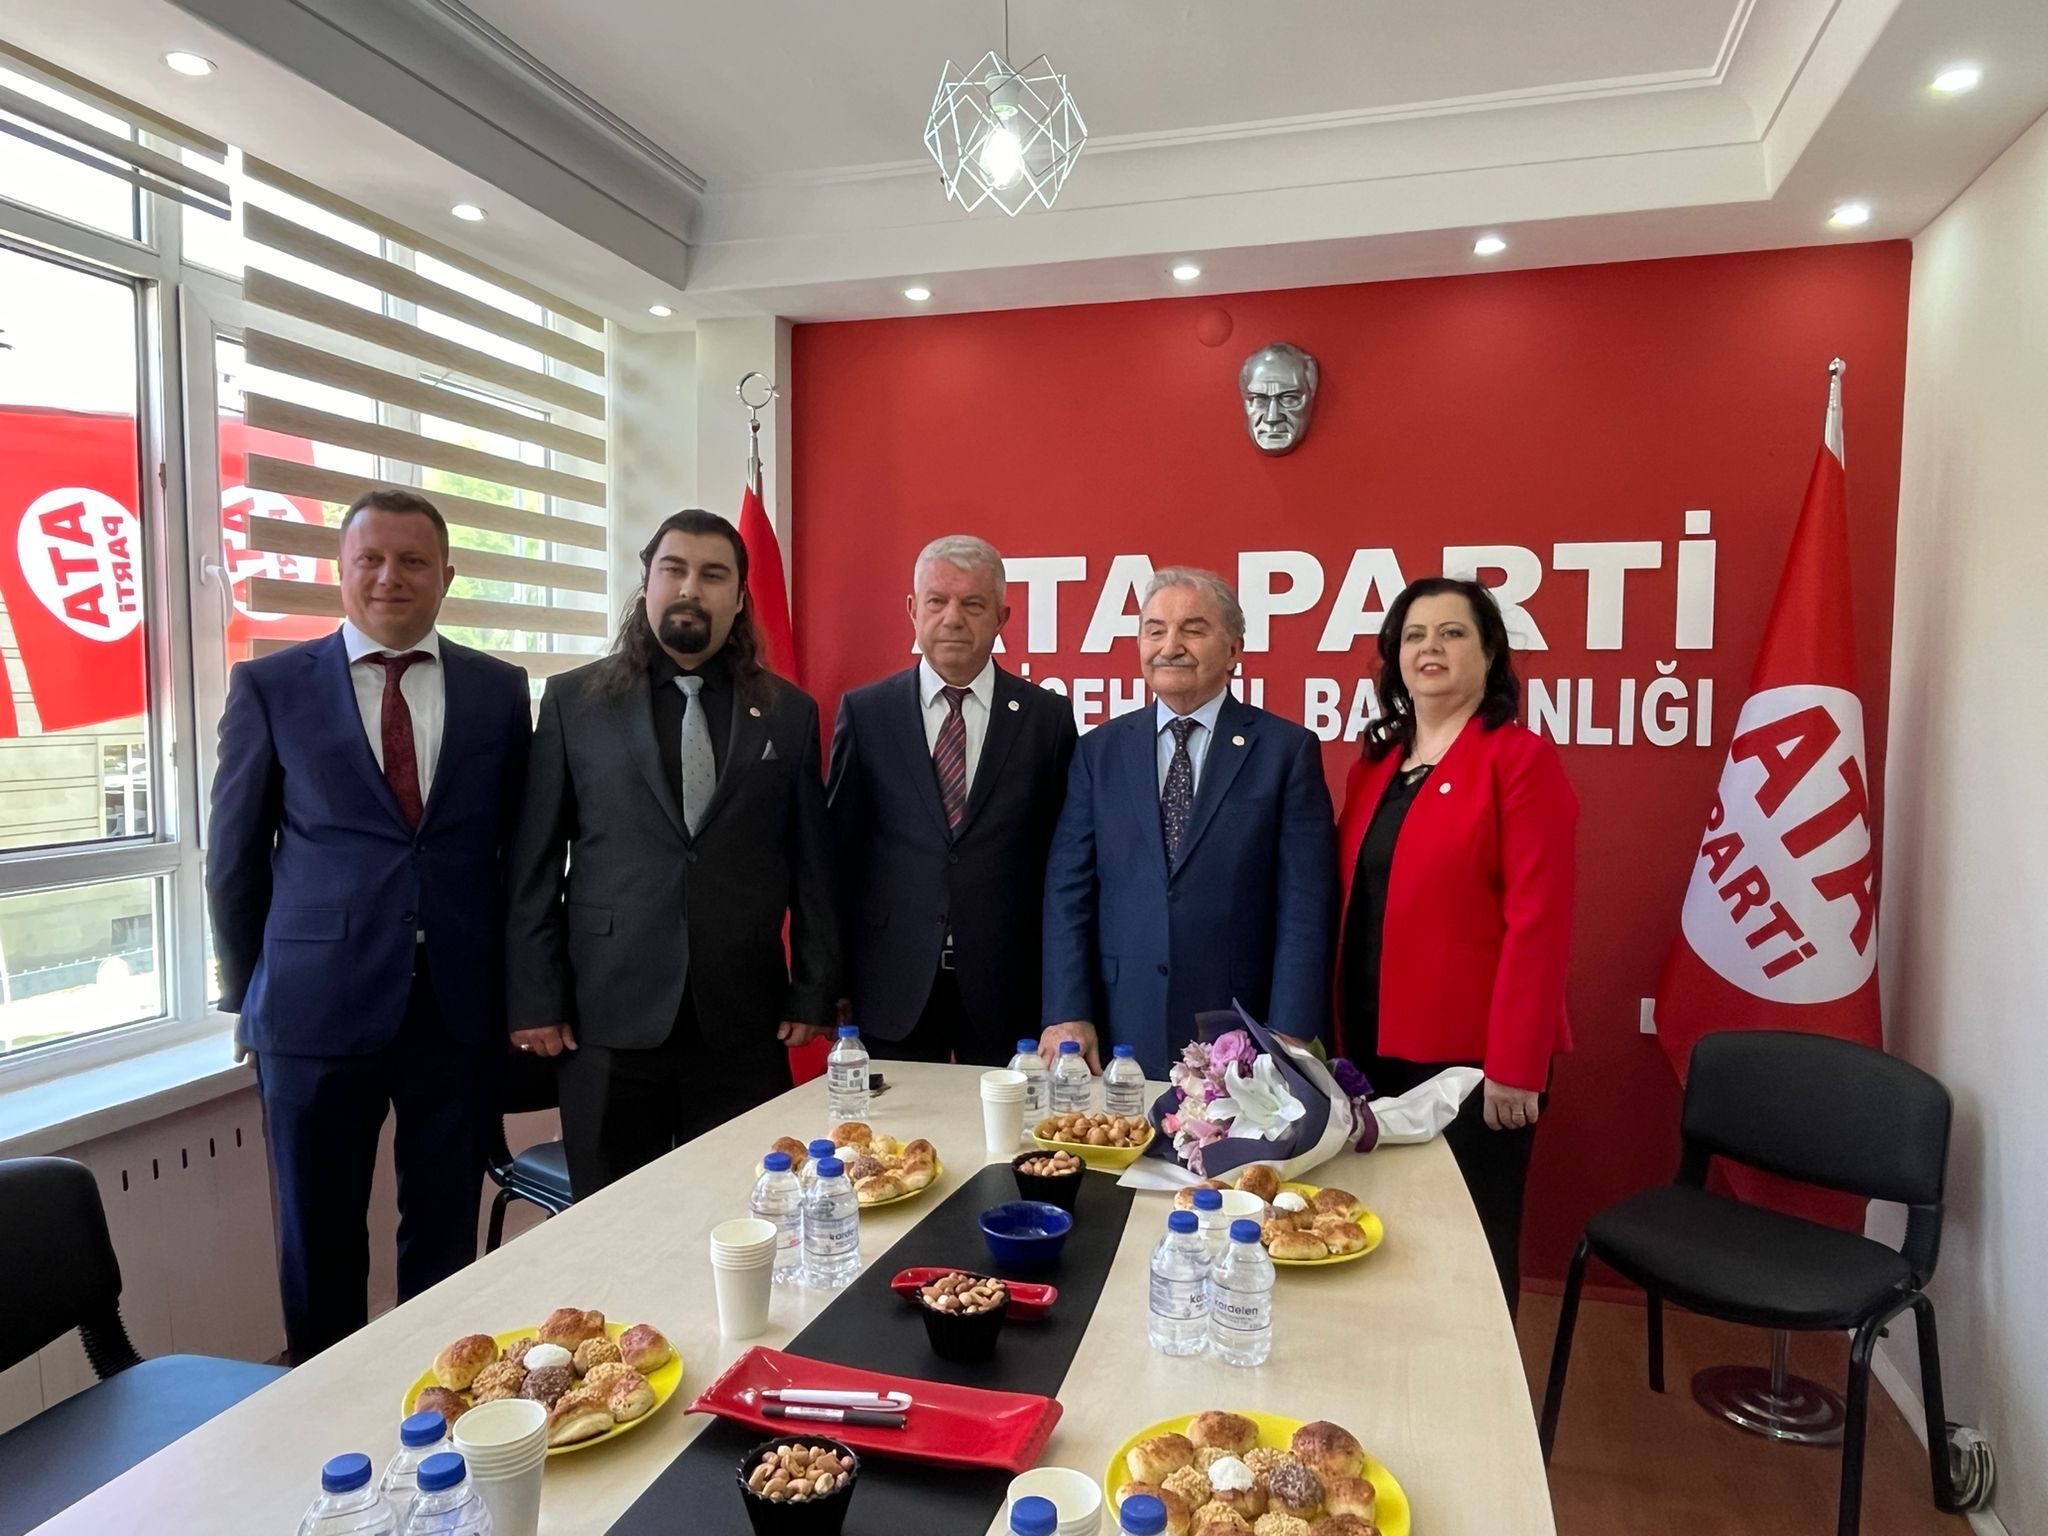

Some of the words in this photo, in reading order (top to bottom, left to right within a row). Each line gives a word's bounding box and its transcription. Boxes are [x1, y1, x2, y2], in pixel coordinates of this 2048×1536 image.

[911, 554, 1153, 655] TA
[1237, 510, 1716, 653] PARTİ
[1304, 660, 1713, 748] BANLIĞI
[1731, 705, 1874, 956] ATA
